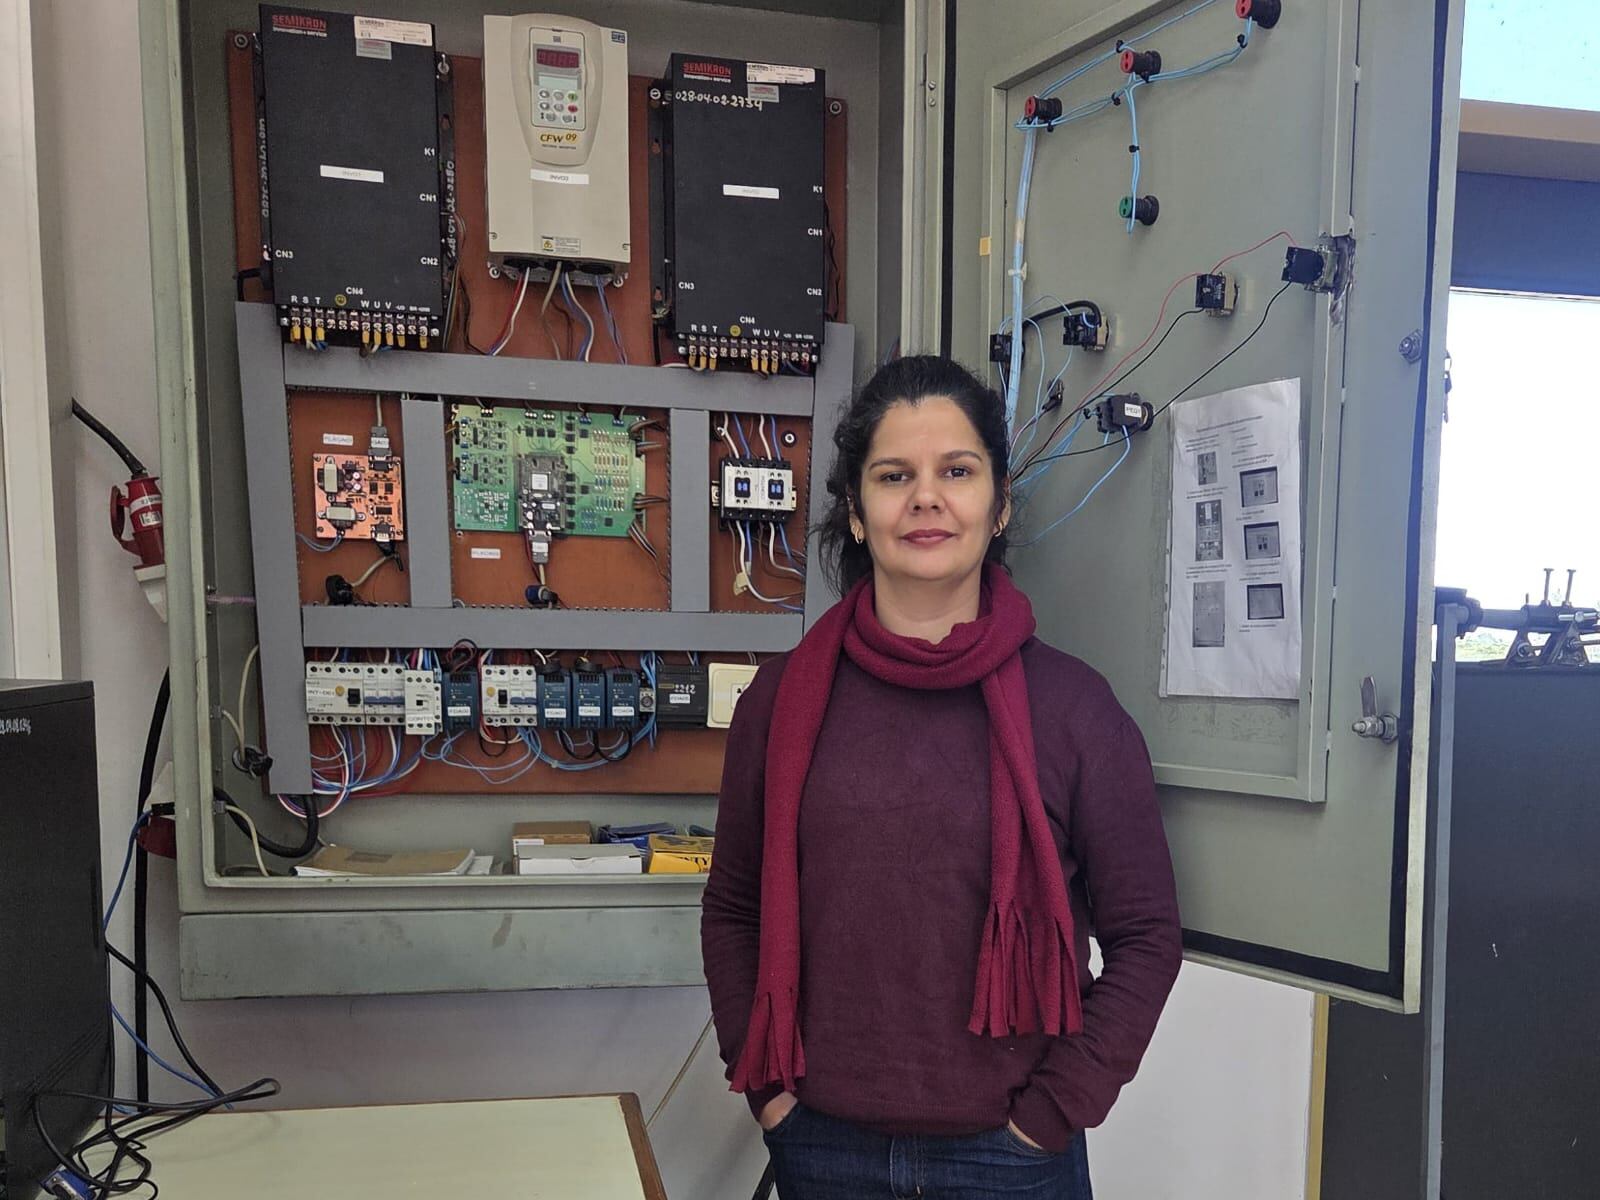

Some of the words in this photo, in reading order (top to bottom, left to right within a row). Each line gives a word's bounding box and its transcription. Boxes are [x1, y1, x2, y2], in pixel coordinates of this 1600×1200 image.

[272, 14, 327, 30] SEMIKRON
[682, 62, 732, 76] SEMIKRON
[540, 133, 564, 144] CFW
[565, 132, 578, 142] 09
[424, 148, 435, 157] K1
[812, 185, 823, 194] K1
[419, 193, 437, 202] CN1
[807, 228, 823, 237] CN1
[275, 249, 294, 259] CN3
[420, 256, 438, 266] CN2
[678, 281, 695, 290] CN3
[345, 286, 364, 295] CN4
[807, 287, 823, 296] CN2
[291, 295, 298, 303] R
[302, 296, 309, 304] S
[360, 300, 370, 308] W
[385, 301, 392, 309] V
[739, 316, 756, 325] CN4
[691, 324, 697, 333] R
[701, 325, 707, 333] S
[712, 326, 718, 334] T
[752, 328, 761, 337] W
[764, 329, 770, 337] U
[774, 330, 780, 338] V
